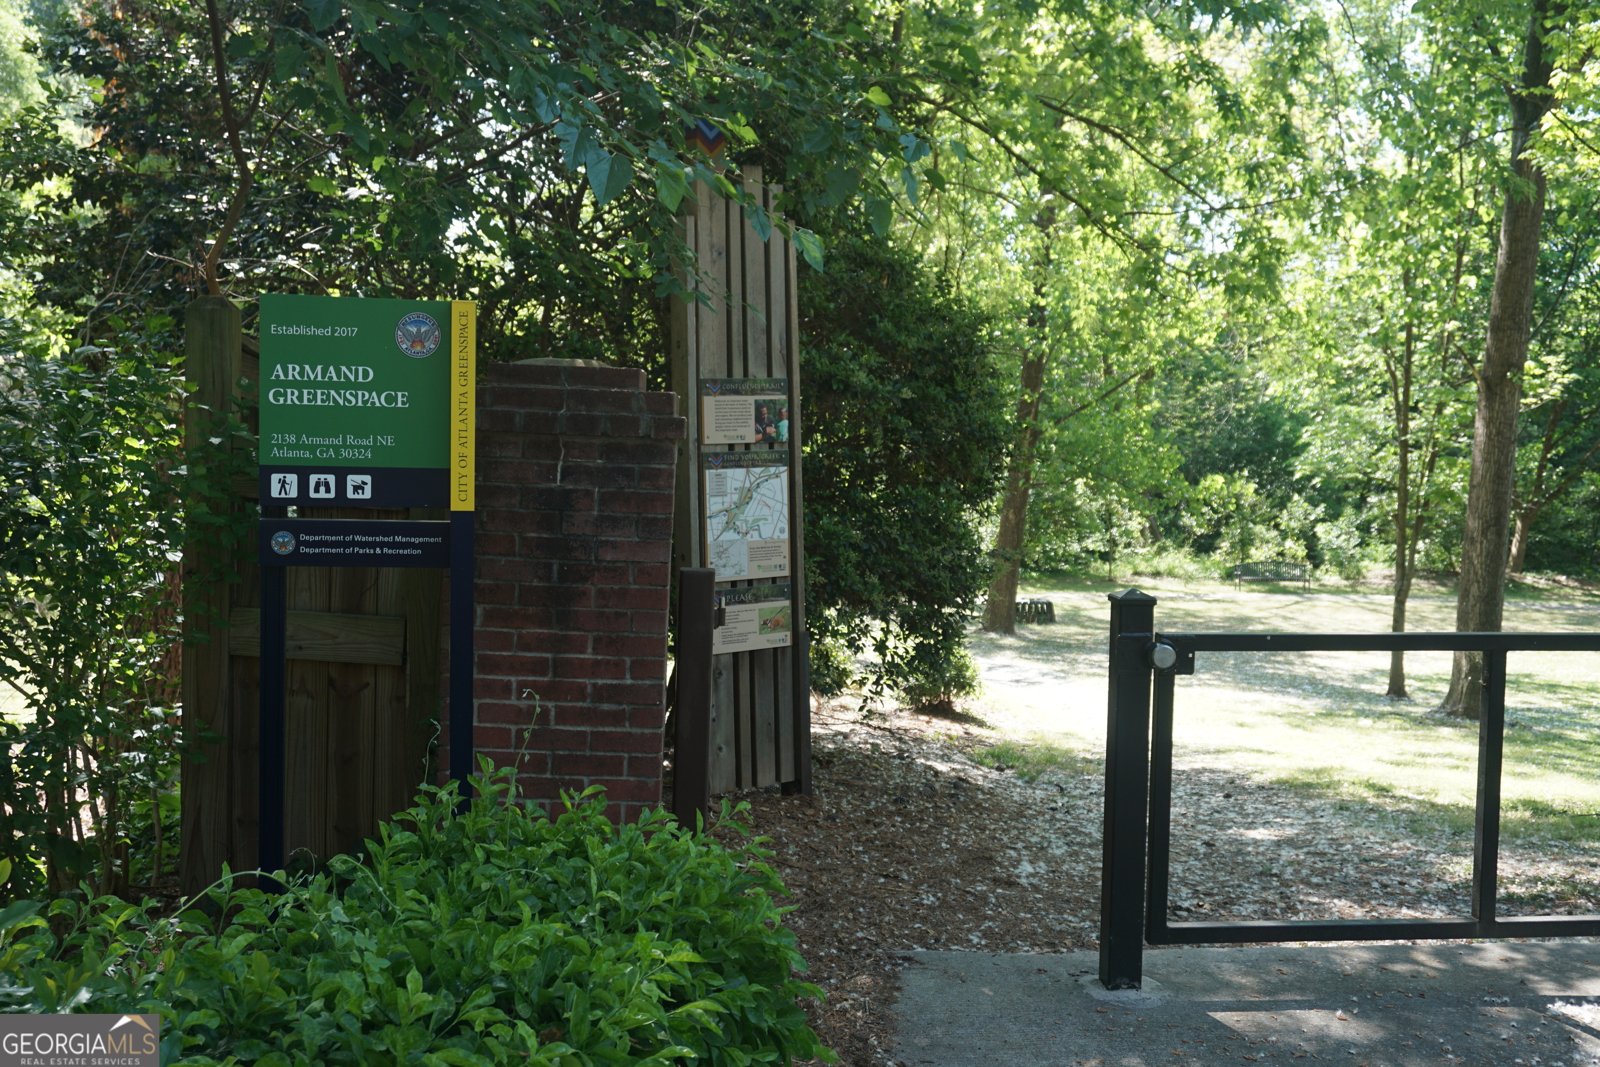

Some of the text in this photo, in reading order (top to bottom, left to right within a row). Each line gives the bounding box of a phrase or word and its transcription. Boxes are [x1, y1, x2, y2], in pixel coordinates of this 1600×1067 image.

[271, 324, 358, 337] Established 2017
[270, 363, 374, 383] ARMAND
[268, 387, 409, 408] GREENSPACE
[458, 311, 469, 502] CITY OF ATLANTA GREENSPACE
[271, 434, 396, 446] 2138 Armand Road NE
[270, 447, 372, 459] Atlanta, GA 30324
[300, 533, 344, 542] Department
[354, 534, 393, 542] Watershed
[394, 535, 442, 544] Management
[300, 546, 344, 554] Department
[383, 547, 422, 555] Recreation
